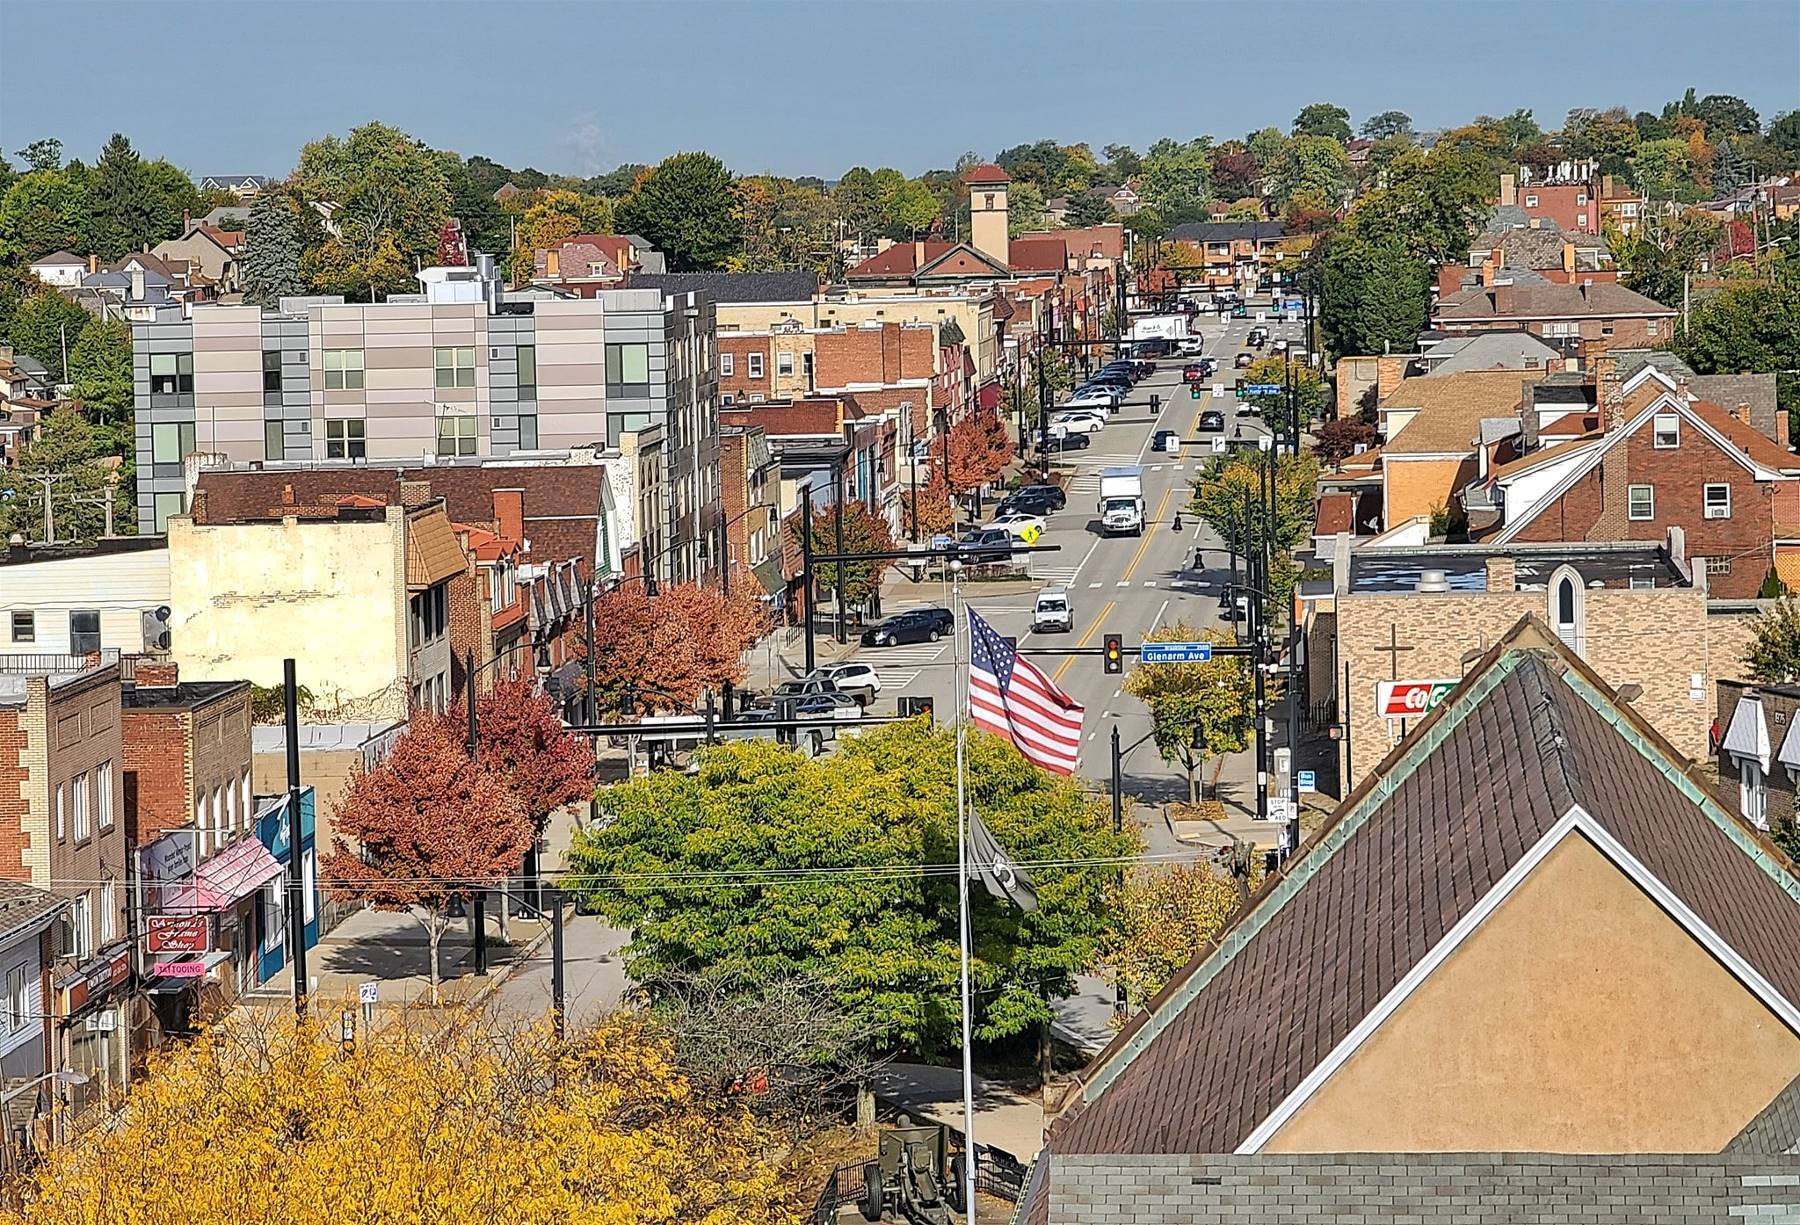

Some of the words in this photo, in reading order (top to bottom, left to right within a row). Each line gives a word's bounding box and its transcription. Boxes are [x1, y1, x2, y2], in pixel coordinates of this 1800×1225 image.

[1147, 652, 1185, 660] Glenarm
[1188, 652, 1205, 660] Ave
[158, 965, 201, 974] TATTOOING
